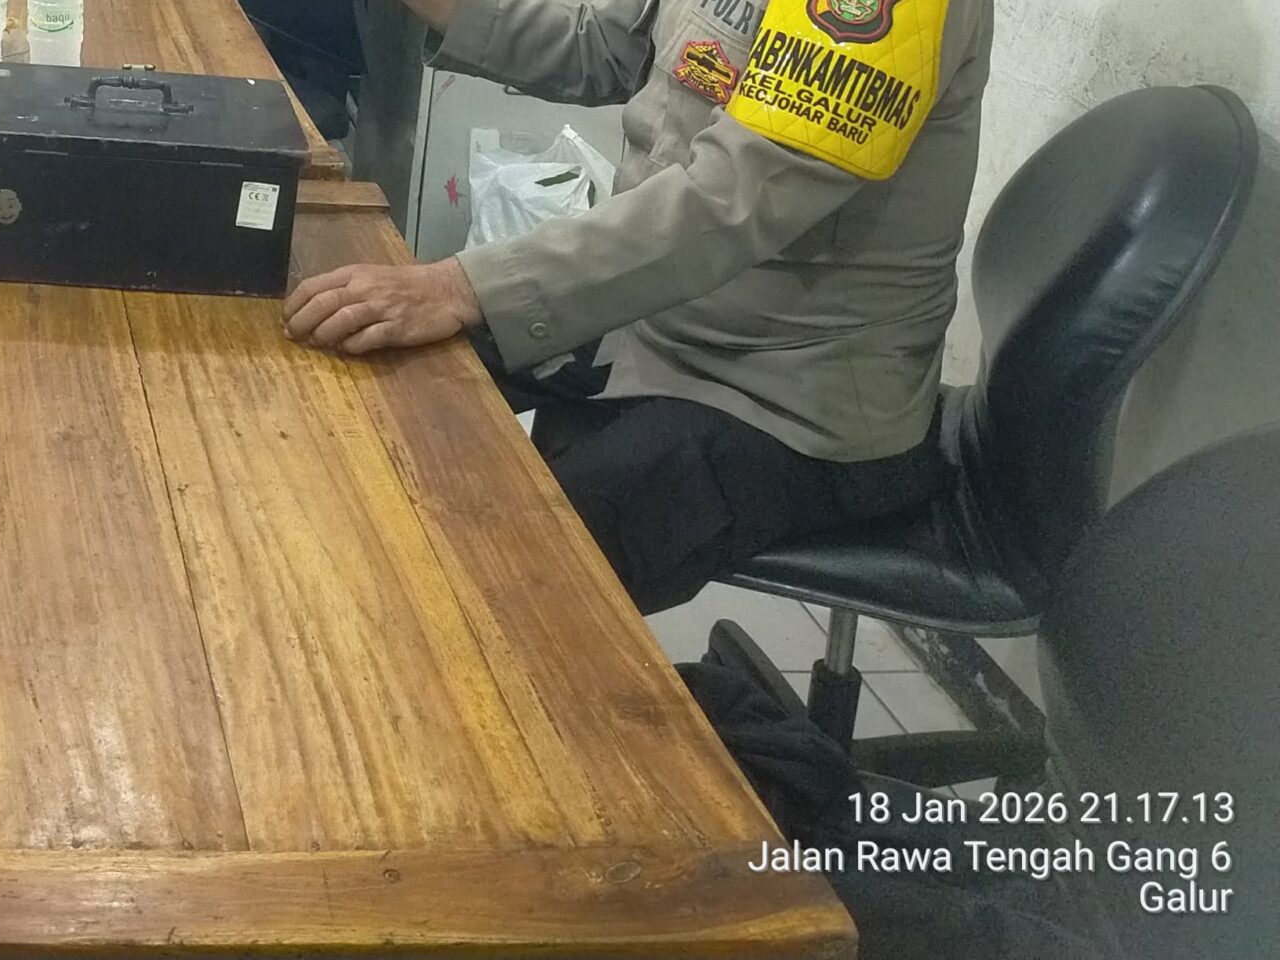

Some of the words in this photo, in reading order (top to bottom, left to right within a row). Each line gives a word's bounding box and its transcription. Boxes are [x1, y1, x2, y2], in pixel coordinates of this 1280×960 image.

[743, 70, 877, 133] KEL.GALUR
[751, 27, 921, 131] ABINKAMTIBMAS
[826, 116, 869, 145] BARU
